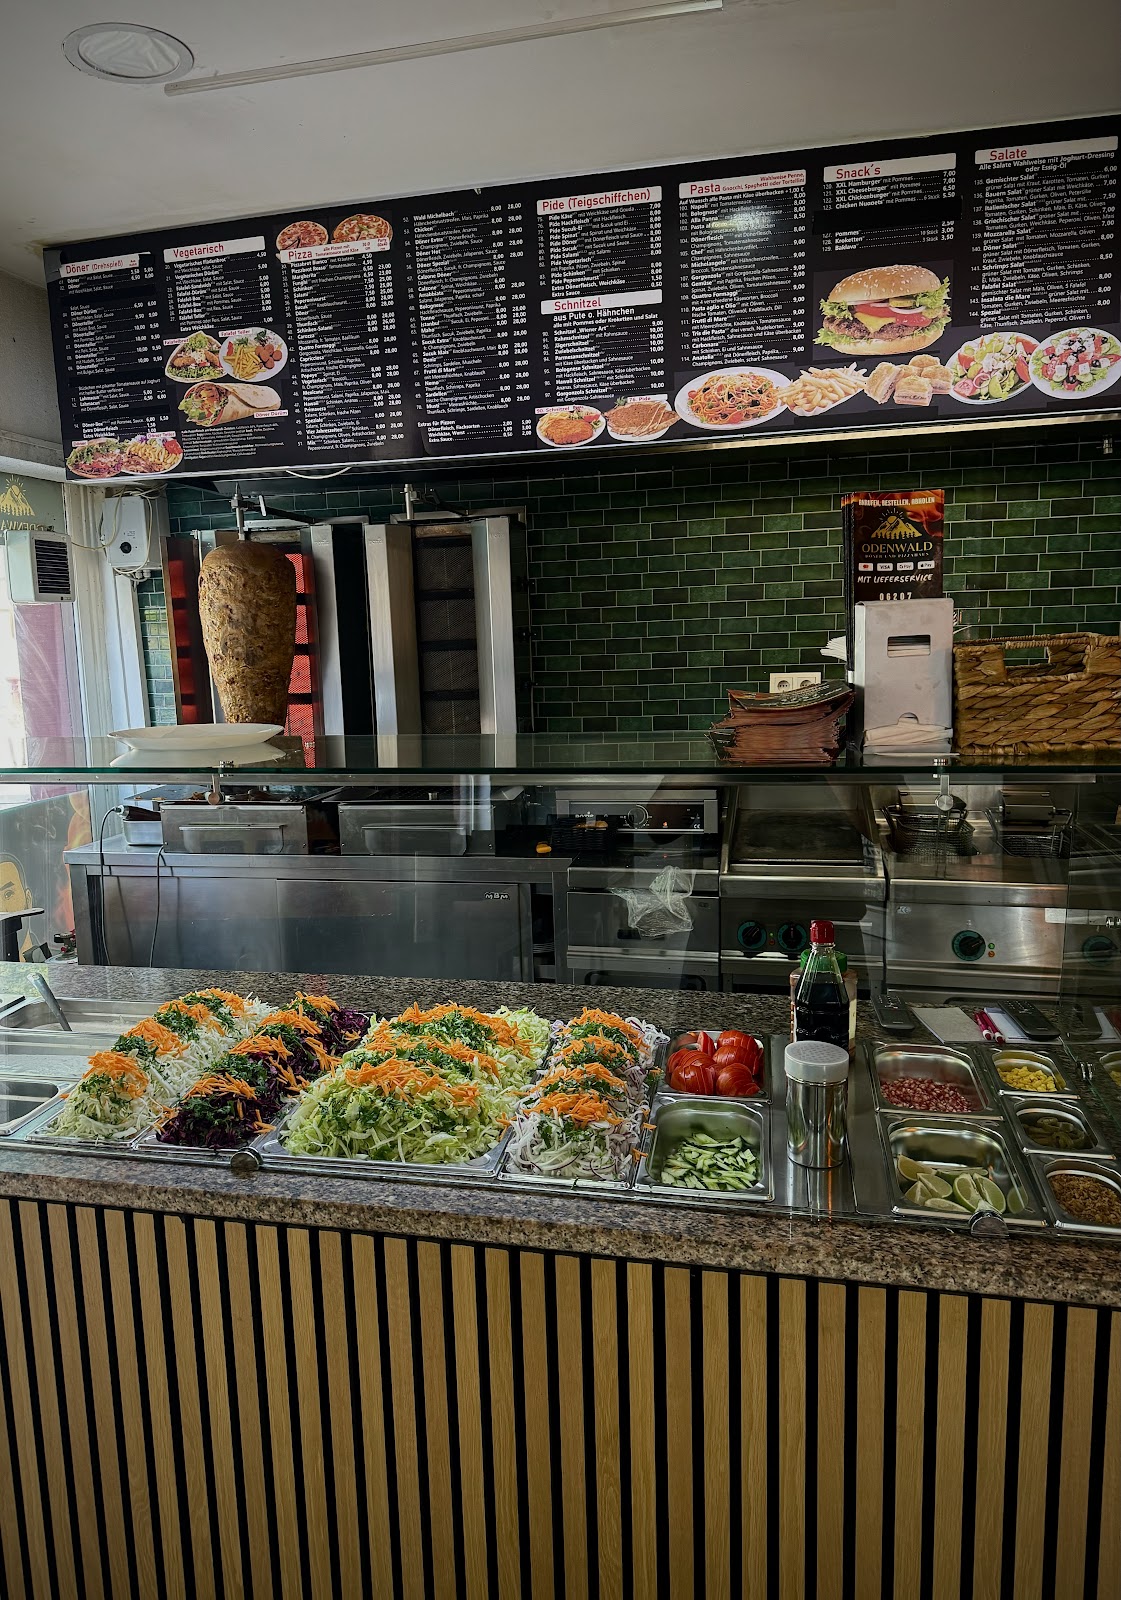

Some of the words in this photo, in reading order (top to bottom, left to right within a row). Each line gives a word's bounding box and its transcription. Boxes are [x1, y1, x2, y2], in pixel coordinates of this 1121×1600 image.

[990, 149, 1027, 161] Salate
[1013, 159, 1046, 167] Wahlweise
[1060, 152, 1114, 163] Joghurt-Dressing
[1042, 163, 1067, 171] Essig-Öl
[848, 179, 881, 187] Hamburger
[943, 170, 956, 178] 7,00
[986, 176, 1019, 184] Gemischter
[690, 183, 721, 194] Pasta
[542, 201, 564, 212] Pide
[568, 189, 651, 209] (Teigschiffchen)
[173, 243, 224, 258] Vegetarisch
[288, 251, 313, 260] Pizza
[66, 264, 89, 274] Döner
[554, 297, 601, 311] Schnitzel
[569, 312, 586, 320] Pute
[596, 307, 635, 317] Hähnchen
[862, 541, 933, 553] ODENWALD
[874, 574, 933, 583] LIEFERSERVICE
